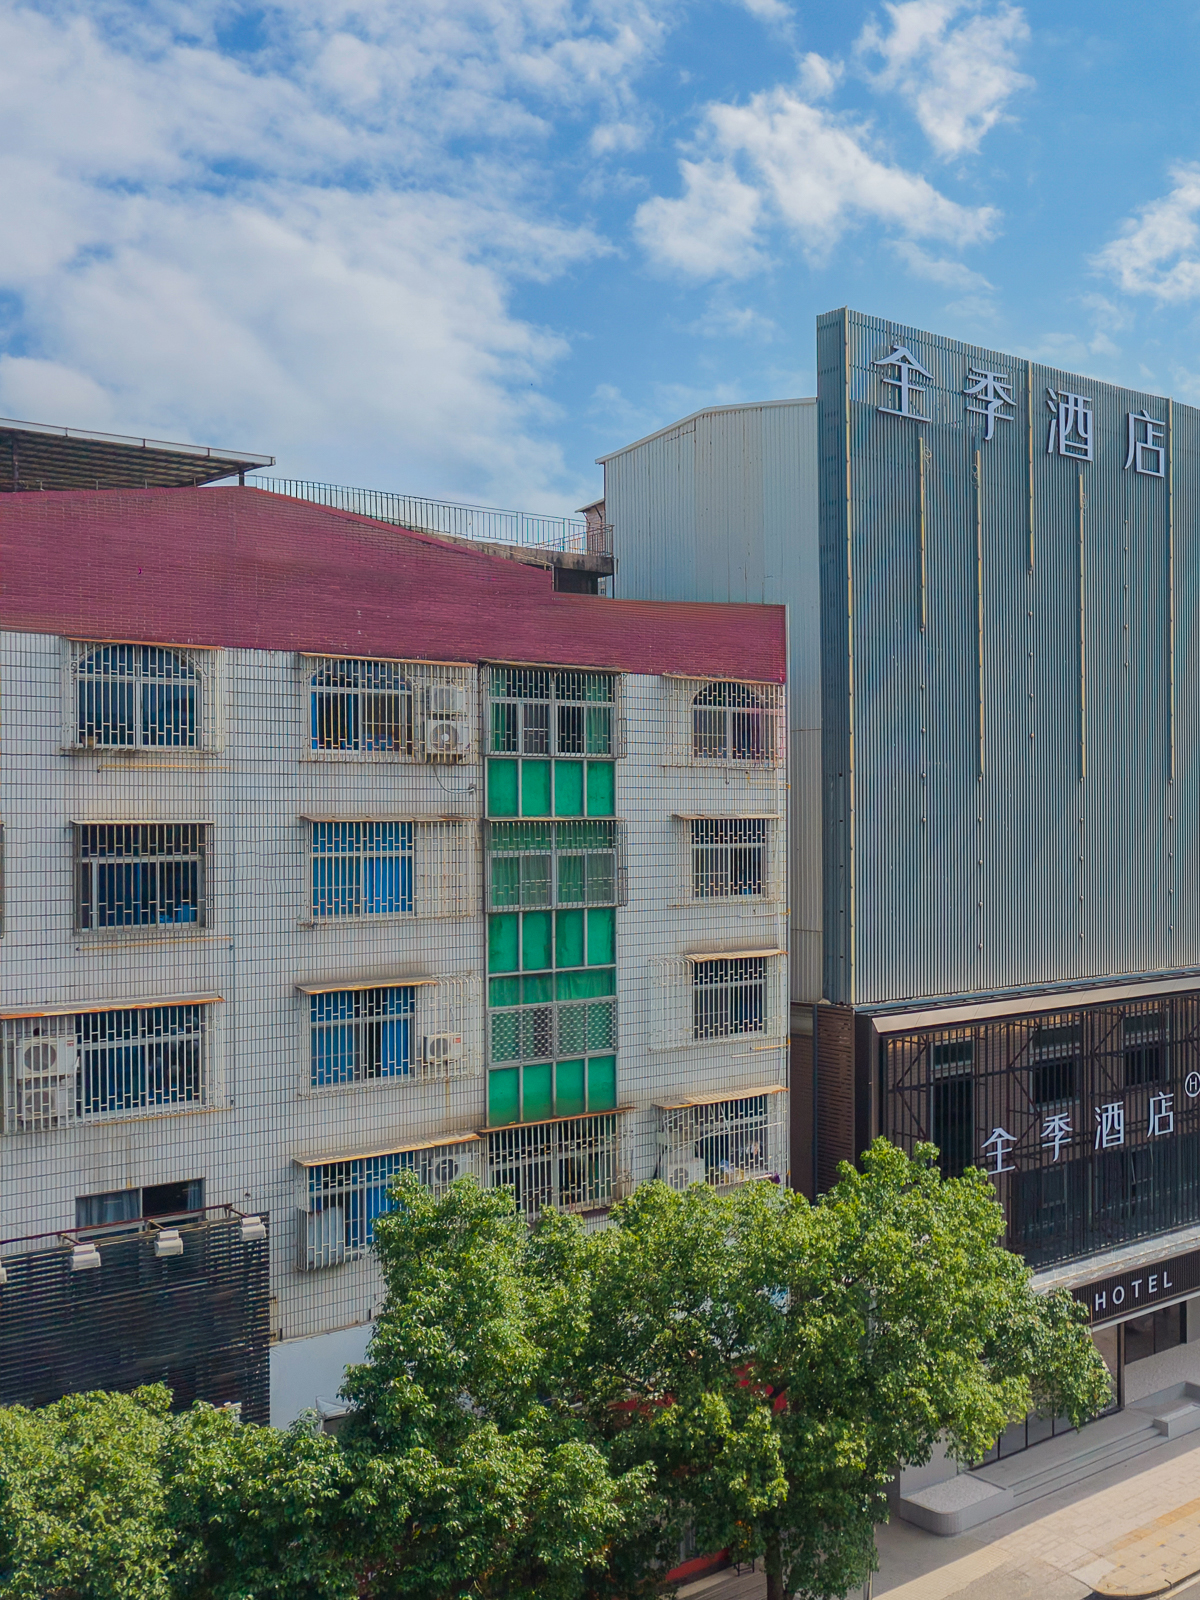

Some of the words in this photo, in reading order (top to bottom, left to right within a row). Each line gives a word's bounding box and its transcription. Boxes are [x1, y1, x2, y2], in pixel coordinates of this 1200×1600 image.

[872, 345, 1165, 478] 全季酒店
[981, 1091, 1175, 1176] 全季酒店
[1095, 1271, 1173, 1312] HOTEL
